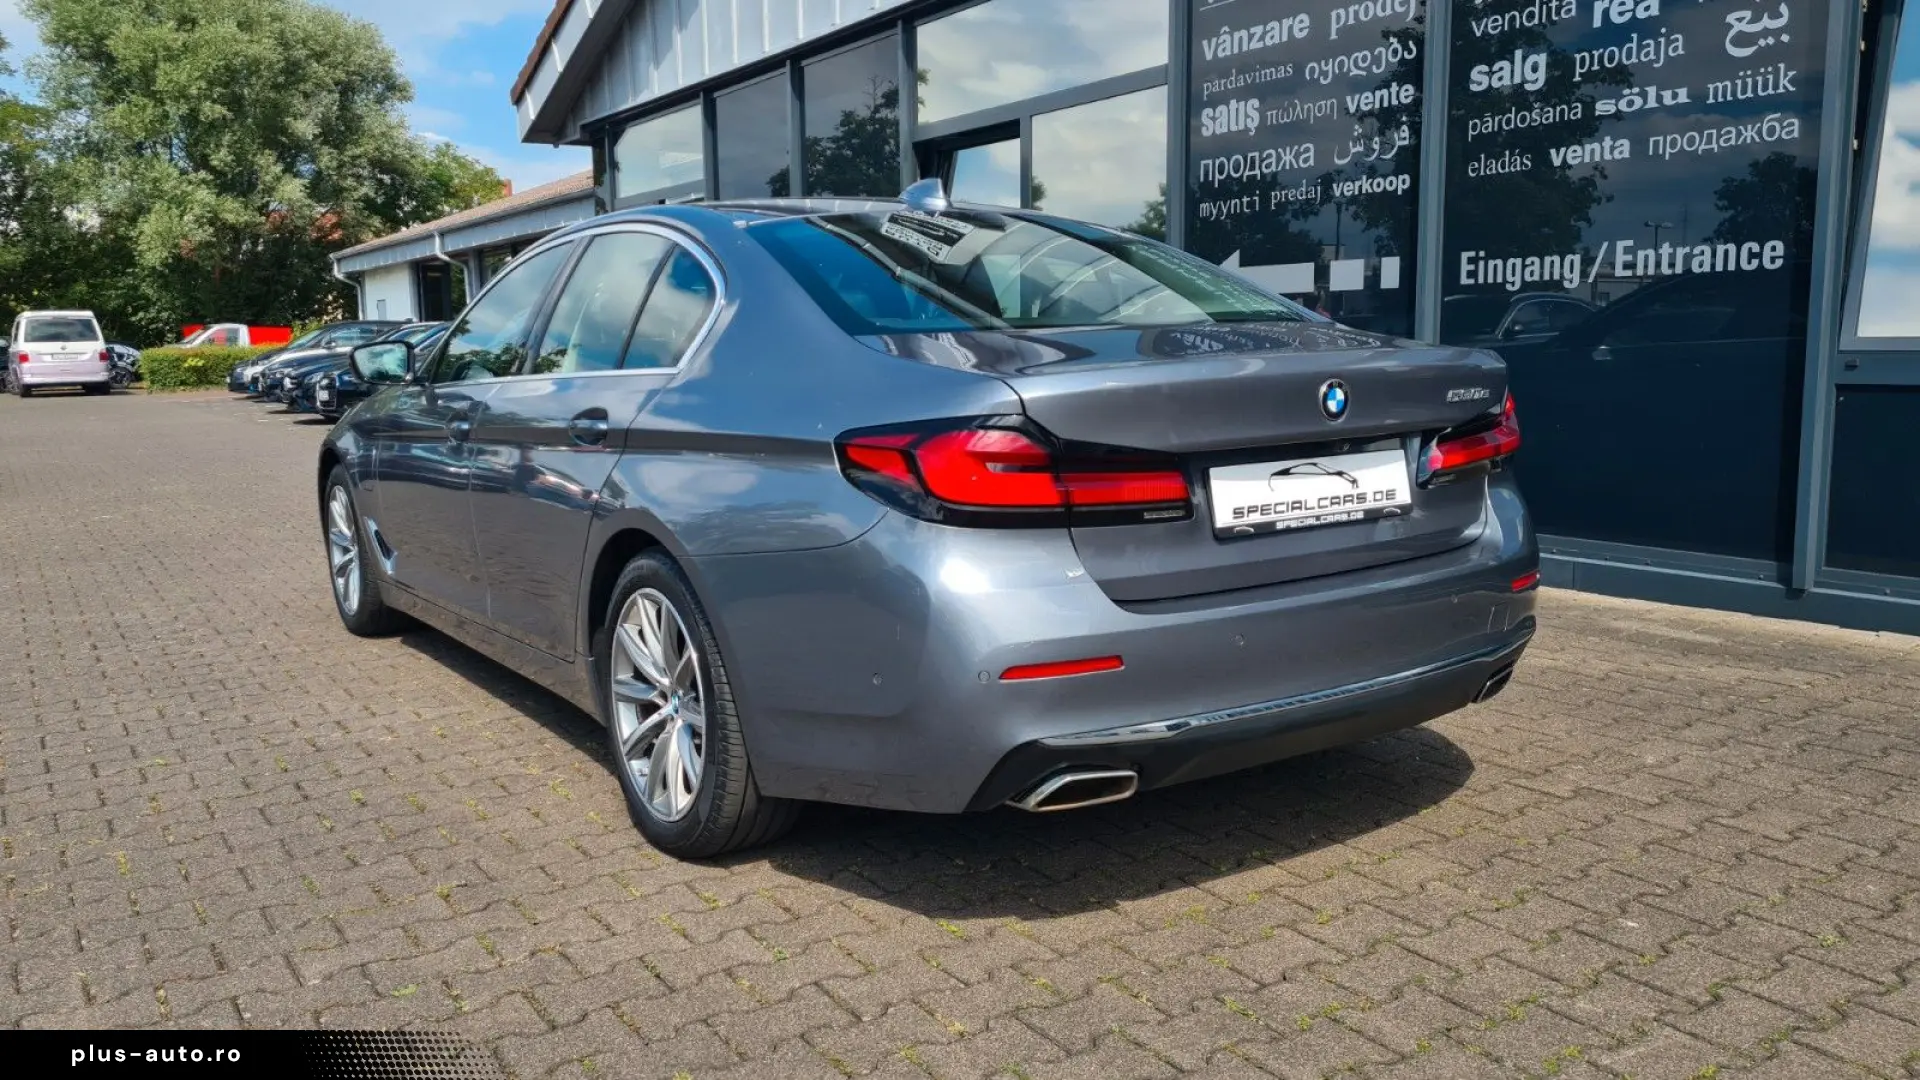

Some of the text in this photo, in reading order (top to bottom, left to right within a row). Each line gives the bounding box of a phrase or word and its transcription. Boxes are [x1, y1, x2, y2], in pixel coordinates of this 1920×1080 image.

[1202, 13, 1310, 60] vânzare
[1471, 0, 1577, 37] vendita
[1469, 1, 1790, 91] salg prodaja بيع
[1203, 64, 1293, 100] pardavimas
[1468, 63, 1798, 142] pārdošana sölu müük
[1201, 81, 1415, 136] satış πώληση vente
[1200, 115, 1410, 188] продажа فروش
[1468, 113, 1800, 178] eladás venta продажба
[1200, 173, 1411, 220] myynti predaj verkoop
[1232, 489, 1397, 519] SPECIALCARS.DE
